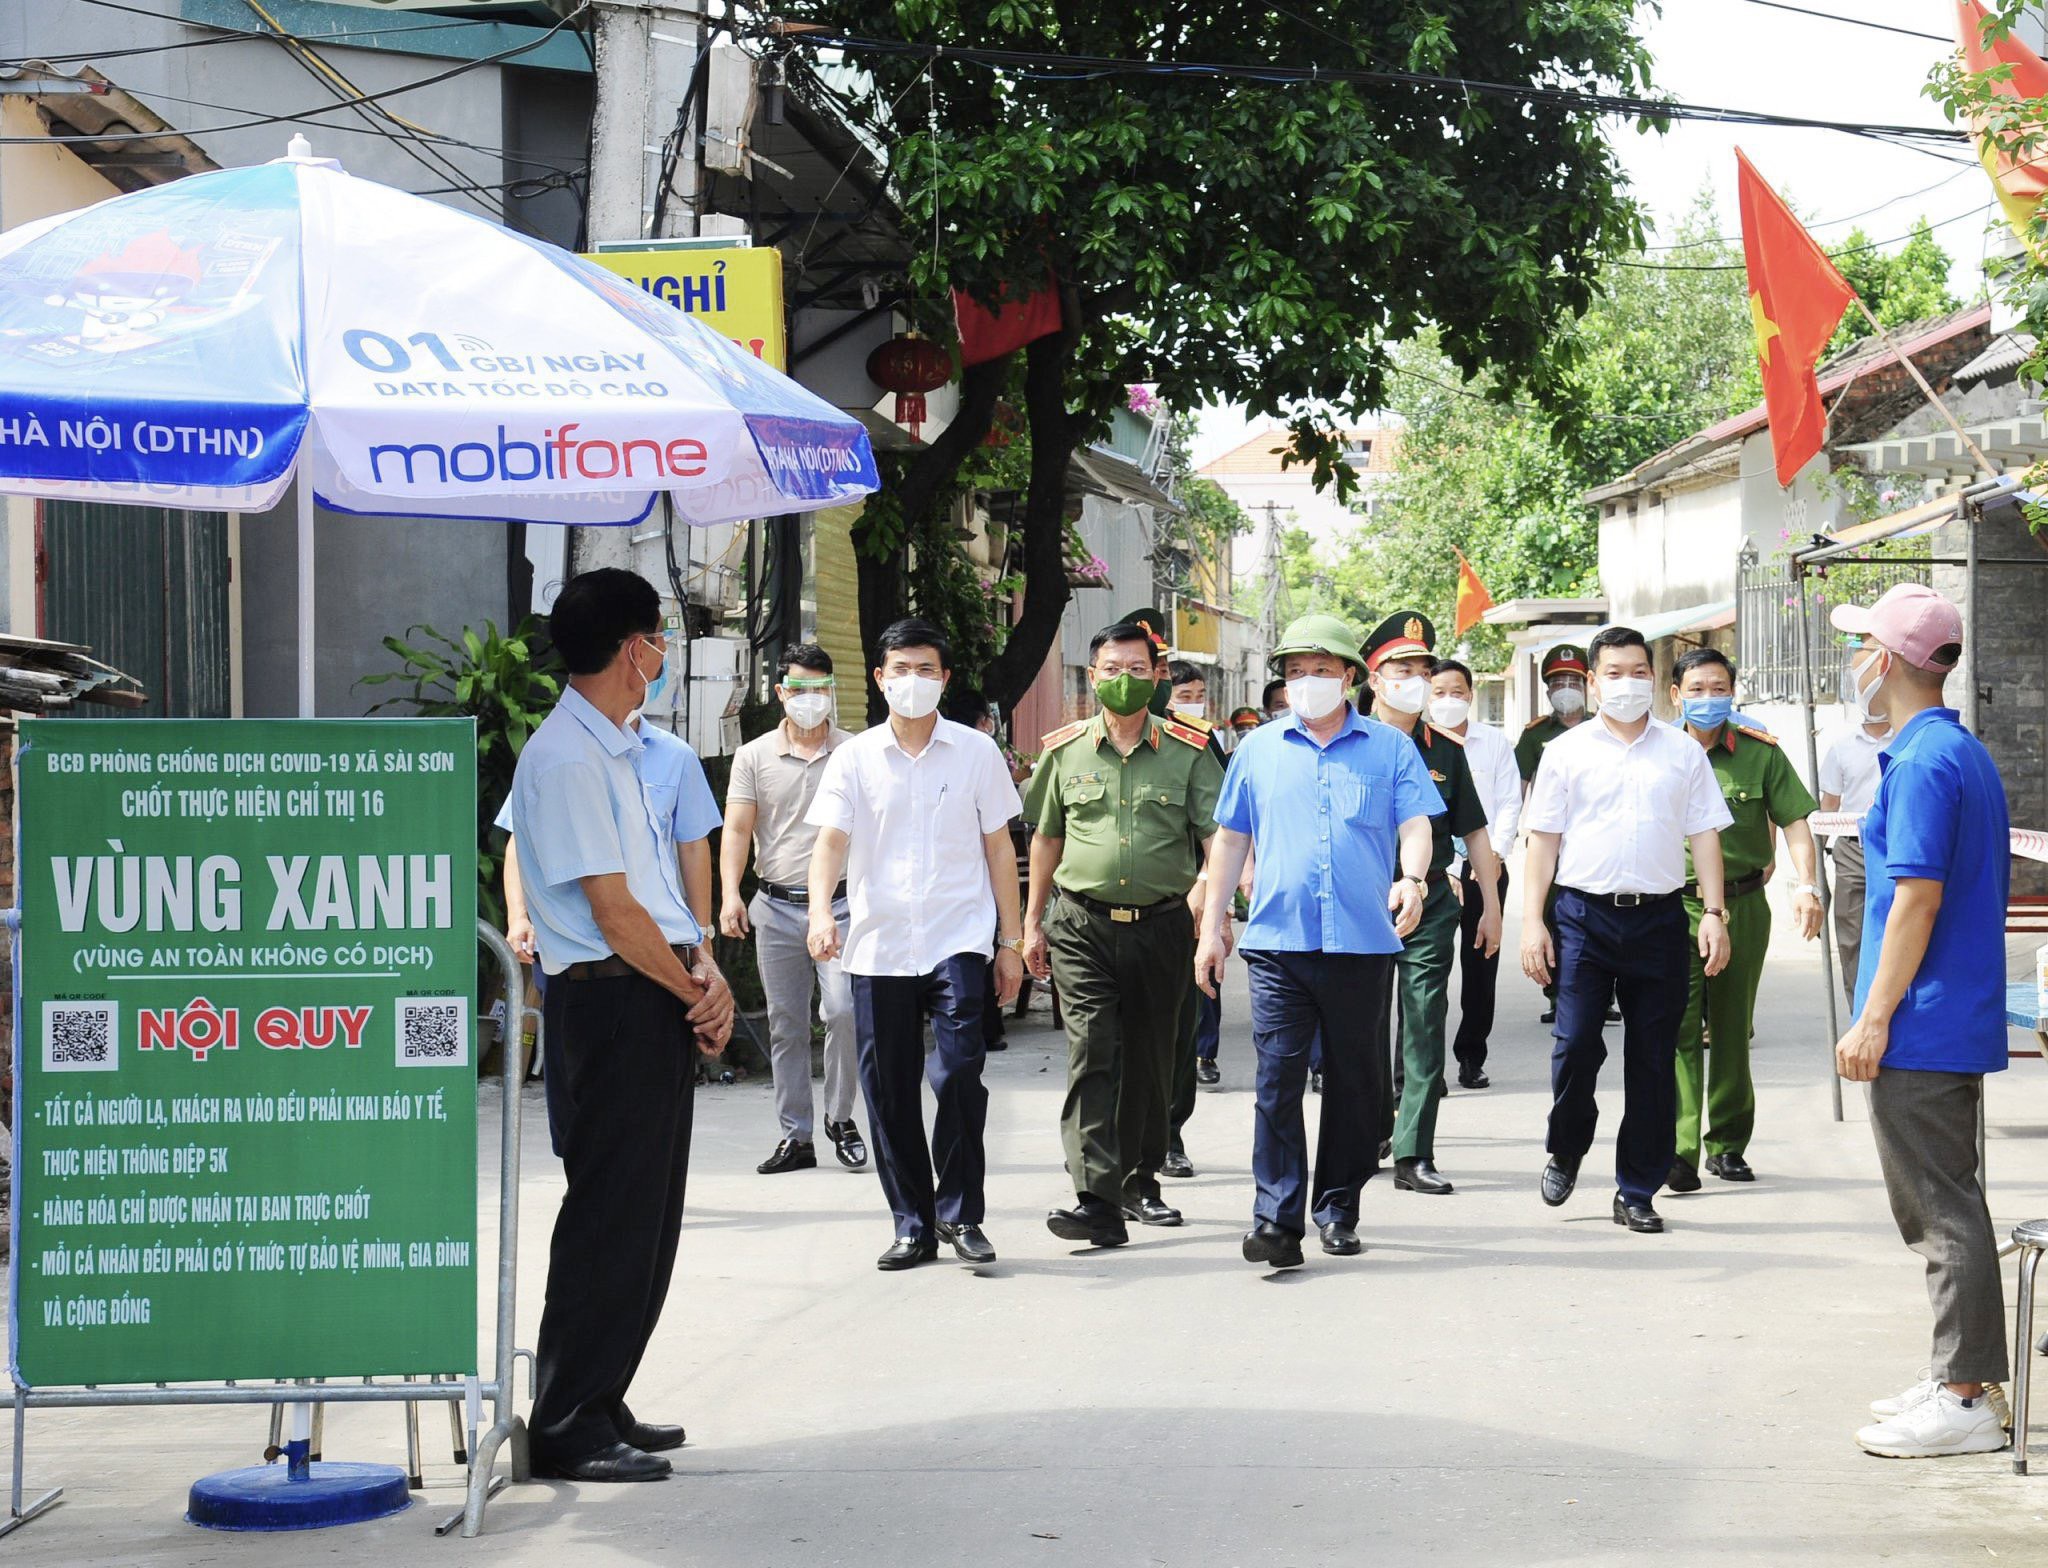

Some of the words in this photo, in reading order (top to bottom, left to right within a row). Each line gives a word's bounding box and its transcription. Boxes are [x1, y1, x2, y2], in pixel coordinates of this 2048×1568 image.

[343, 329, 463, 374] 01
[541, 348, 647, 374] NGÀY
[373, 381, 466, 398] DATA
[598, 381, 670, 399] CAO
[59, 416, 122, 455] NỘI
[132, 421, 265, 460] (DTHN)
[368, 423, 708, 485] mobifone
[48, 754, 83, 772] BCĐ
[91, 749, 151, 772] PHÒNG
[158, 747, 217, 772] CHỐNG
[224, 754, 264, 777] DỊCH
[271, 754, 349, 772] COVID-19
[356, 750, 378, 772] XÃ
[384, 750, 412, 772] SÀI
[419, 751, 453, 772] SƠN
[123, 781, 172, 816] CHỐT
[178, 788, 228, 822] THỰC
[235, 785, 280, 822] HIỆN
[287, 782, 318, 816] CHỈ
[325, 790, 354, 821] THỊ
[362, 790, 384, 816] 16
[51, 839, 240, 932] VÙNG
[266, 855, 451, 930] XANH
[74, 944, 143, 973] (VÙNG
[151, 949, 179, 966] AN
[187, 943, 242, 966] TOÀN
[252, 943, 327, 966] KHÔNG
[334, 942, 366, 965] CÓ
[373, 947, 433, 970] DỊCH)
[138, 997, 239, 1061] NỘI
[254, 1006, 373, 1050] QUY
[45, 1092, 70, 1125] TẤT
[75, 1092, 93, 1125] CẢ
[98, 1094, 141, 1124] NGƯỜI
[147, 1099, 167, 1129] LẠ,
[173, 1094, 219, 1123] KHÁCH
[224, 1098, 242, 1122] RA
[247, 1093, 273, 1122] VÀO
[278, 1089, 304, 1121] ĐỀU
[310, 1089, 341, 1121] PHẢI
[346, 1096, 378, 1120] KHAI
[383, 1091, 410, 1120] BÁO
[415, 1096, 422, 1119] Y
[427, 1087, 446, 1121] TẾ,
[43, 1148, 79, 1180] THỰC
[84, 1145, 117, 1180] HIỆN
[122, 1144, 168, 1174] THÔNG
[173, 1143, 205, 1178] ĐIỆP
[210, 1148, 227, 1172] 5K
[44, 1195, 82, 1225] HÀNG
[88, 1194, 116, 1224] HÓA
[121, 1190, 144, 1224] CHỈ
[149, 1196, 186, 1228] ĐƯỢC
[192, 1192, 231, 1227] NHẬN
[236, 1197, 257, 1226] TẠI
[262, 1196, 290, 1221] BAN
[295, 1193, 330, 1225] TRỰC
[335, 1186, 370, 1219] CHỐT
[43, 1242, 70, 1275] MỖI
[75, 1245, 93, 1274] CÁ
[99, 1244, 138, 1273] NHÂN
[143, 1240, 171, 1272] ĐỀU
[176, 1239, 208, 1272] PHẢI
[213, 1242, 231, 1271] CÓ
[236, 1242, 244, 1271] Ý
[249, 1240, 284, 1270] THỨC
[289, 1243, 307, 1275] TỰ
[310, 1236, 337, 1269] BẢO
[343, 1239, 358, 1273] VỆ
[364, 1238, 404, 1270] MÌNH,
[409, 1243, 432, 1267] GIA
[436, 1237, 469, 1266] ĐÌNH
[44, 1296, 61, 1326] VÀ
[67, 1295, 106, 1330] CỘNG
[111, 1291, 149, 1324] ĐỒNG
